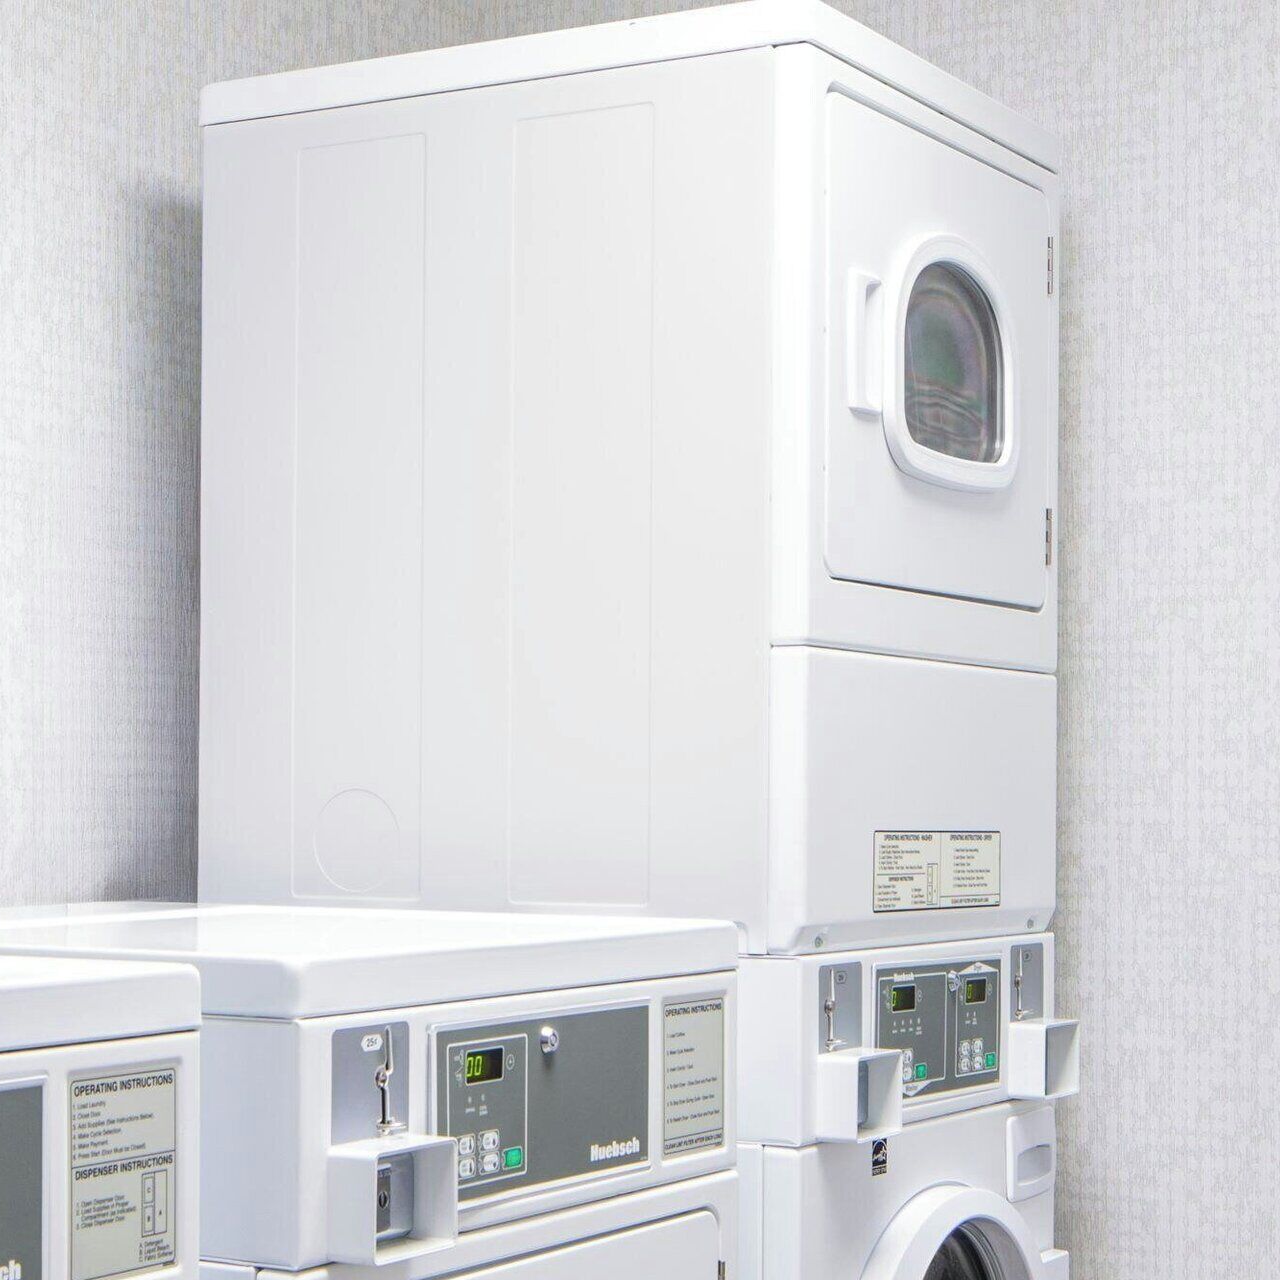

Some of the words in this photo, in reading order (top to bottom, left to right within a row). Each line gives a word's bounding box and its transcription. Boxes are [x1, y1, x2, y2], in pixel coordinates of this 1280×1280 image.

[665, 1006, 690, 1017] OPERATING
[691, 1002, 721, 1013] INSTRUCTIONS
[74, 1081, 118, 1097] OPERATING
[120, 1074, 173, 1090] INSTRUCTIONS
[590, 1136, 640, 1162] Huebsch
[75, 1164, 118, 1181] DISPENSER
[120, 1155, 173, 1172] INSTRUCTIONS
